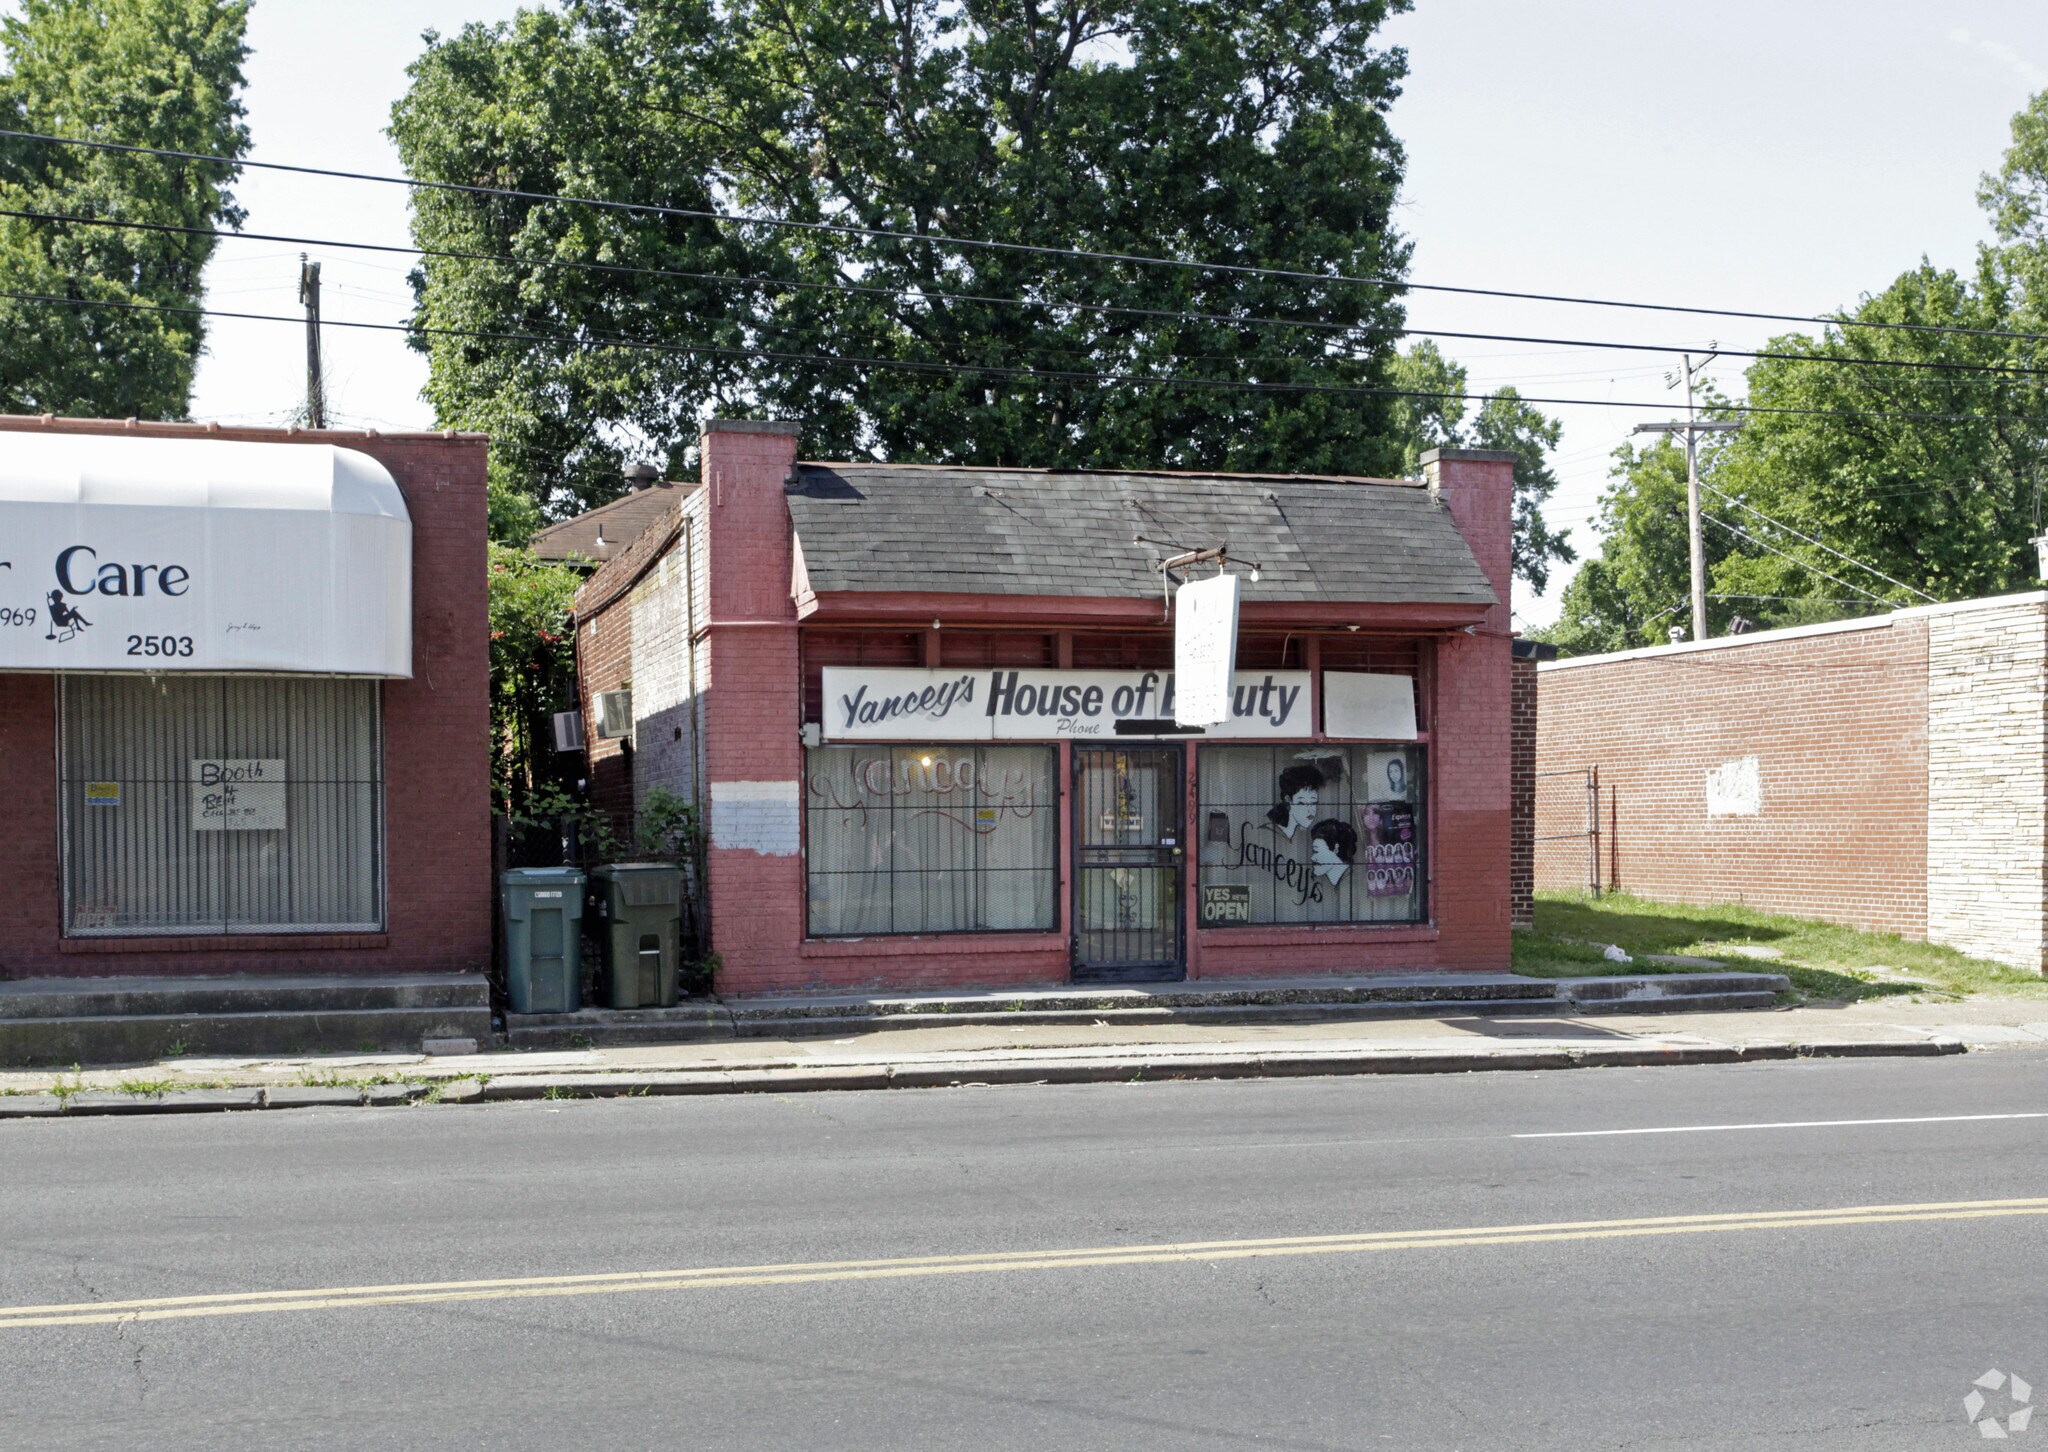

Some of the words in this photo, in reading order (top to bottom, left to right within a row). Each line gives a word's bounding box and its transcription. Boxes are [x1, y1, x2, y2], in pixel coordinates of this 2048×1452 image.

[55, 545, 190, 597] Care
[0, 607, 36, 627] 969
[126, 635, 194, 657] 2503
[841, 674, 976, 729] Yancey's
[985, 671, 1104, 717] House
[1111, 672, 1160, 717] of
[1160, 673, 1301, 727] Buty
[1056, 717, 1101, 735] Phone
[1205, 888, 1231, 901] YES
[1204, 901, 1249, 920] OPEN
